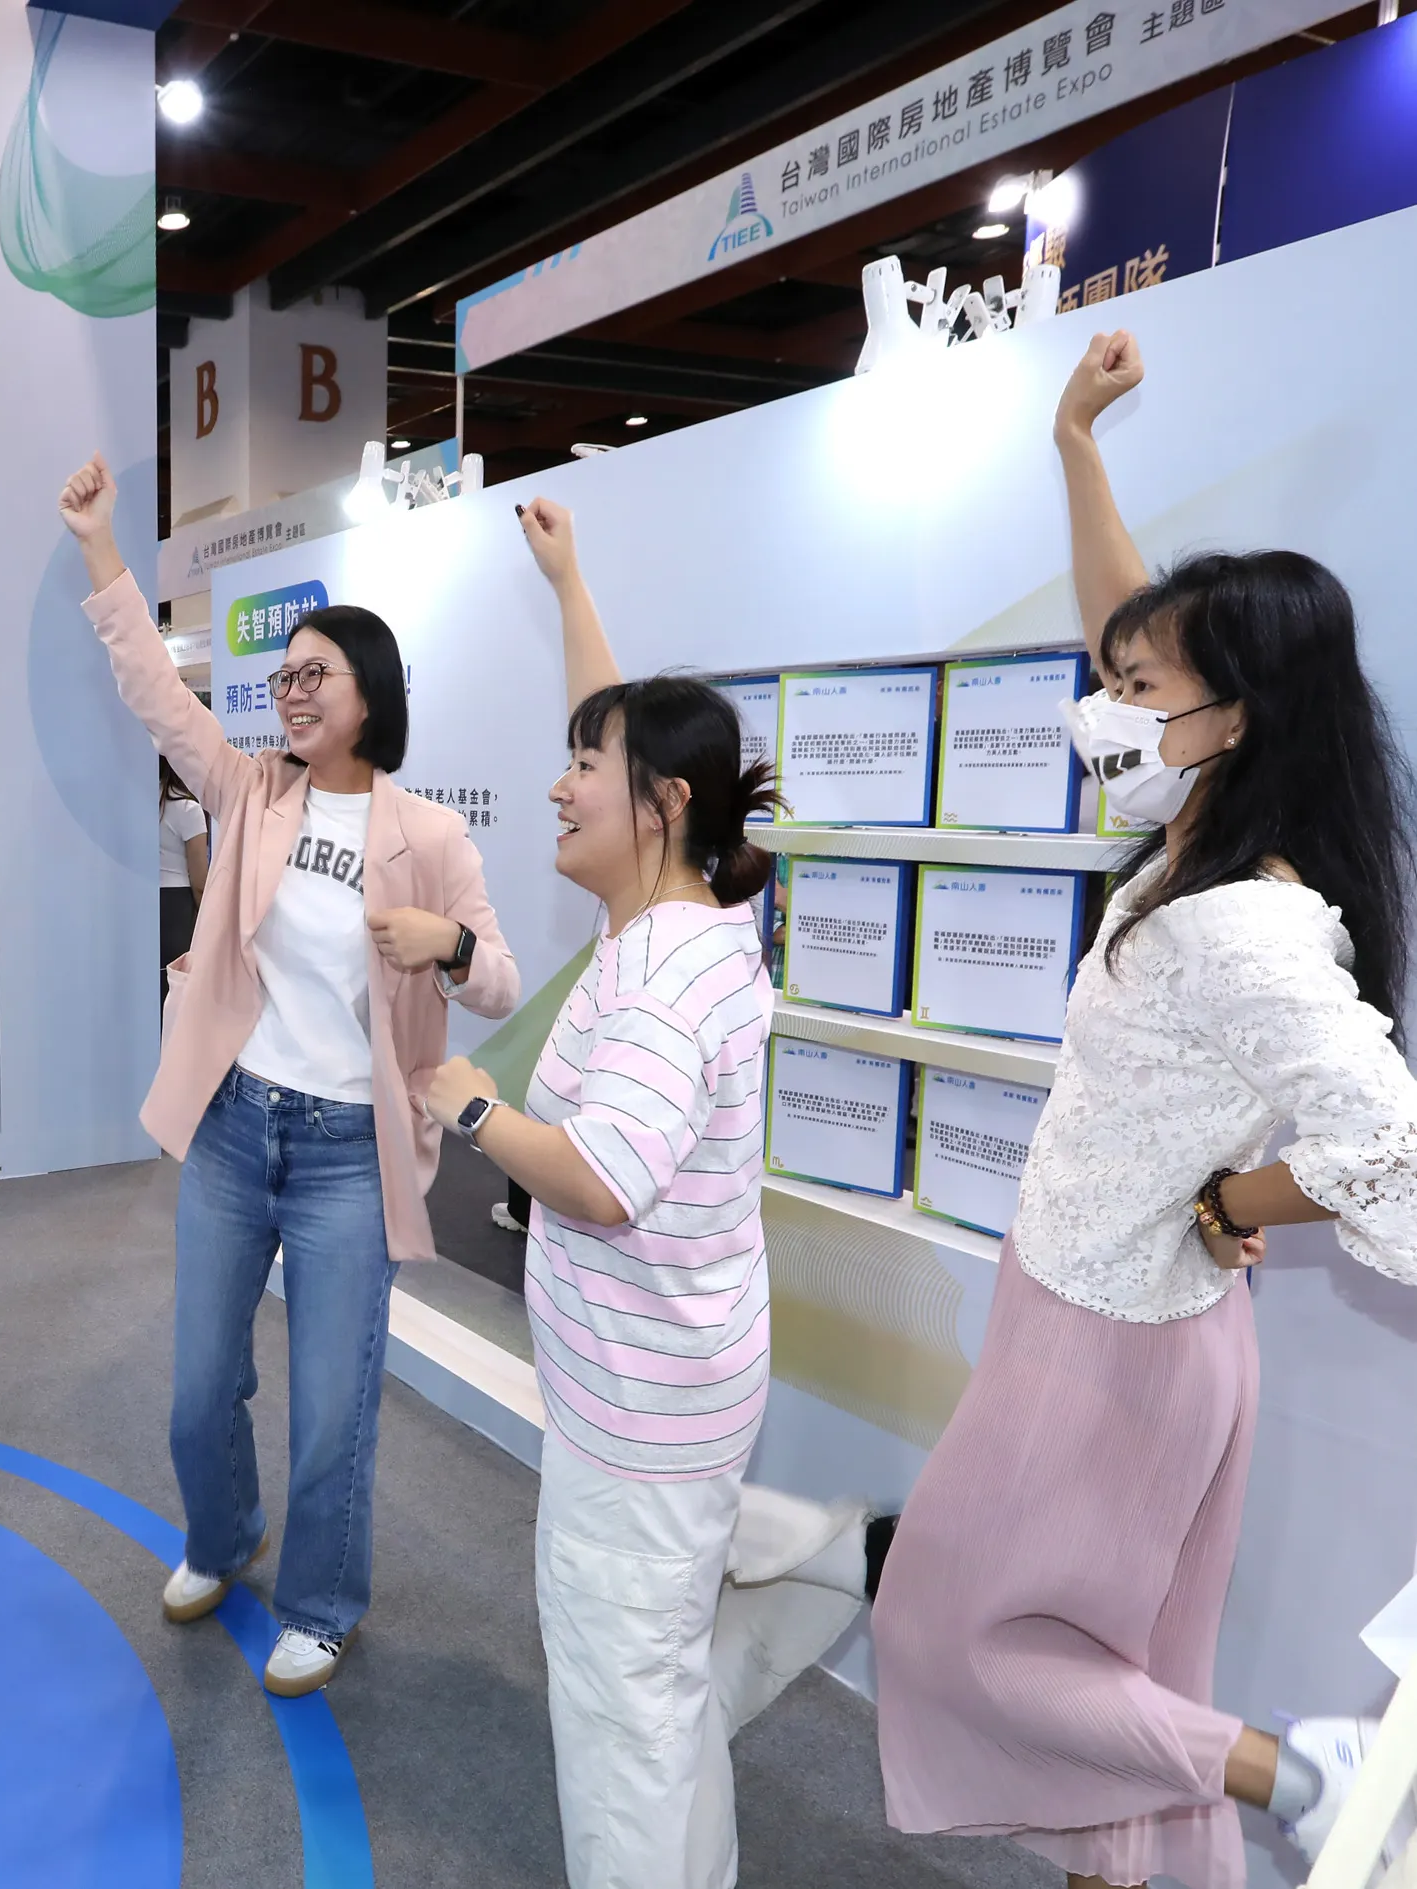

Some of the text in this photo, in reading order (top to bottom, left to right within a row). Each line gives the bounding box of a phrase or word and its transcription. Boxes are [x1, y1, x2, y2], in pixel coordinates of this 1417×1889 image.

[780, 12, 1116, 193] 台灣國際房地產博覽會
[781, 63, 1113, 219] Taiwan International Estate Expo
[721, 221, 762, 252] TIEE
[195, 360, 220, 440] B
[298, 343, 342, 422] B
[226, 682, 274, 714] 預防三
[286, 835, 364, 896] ORG
